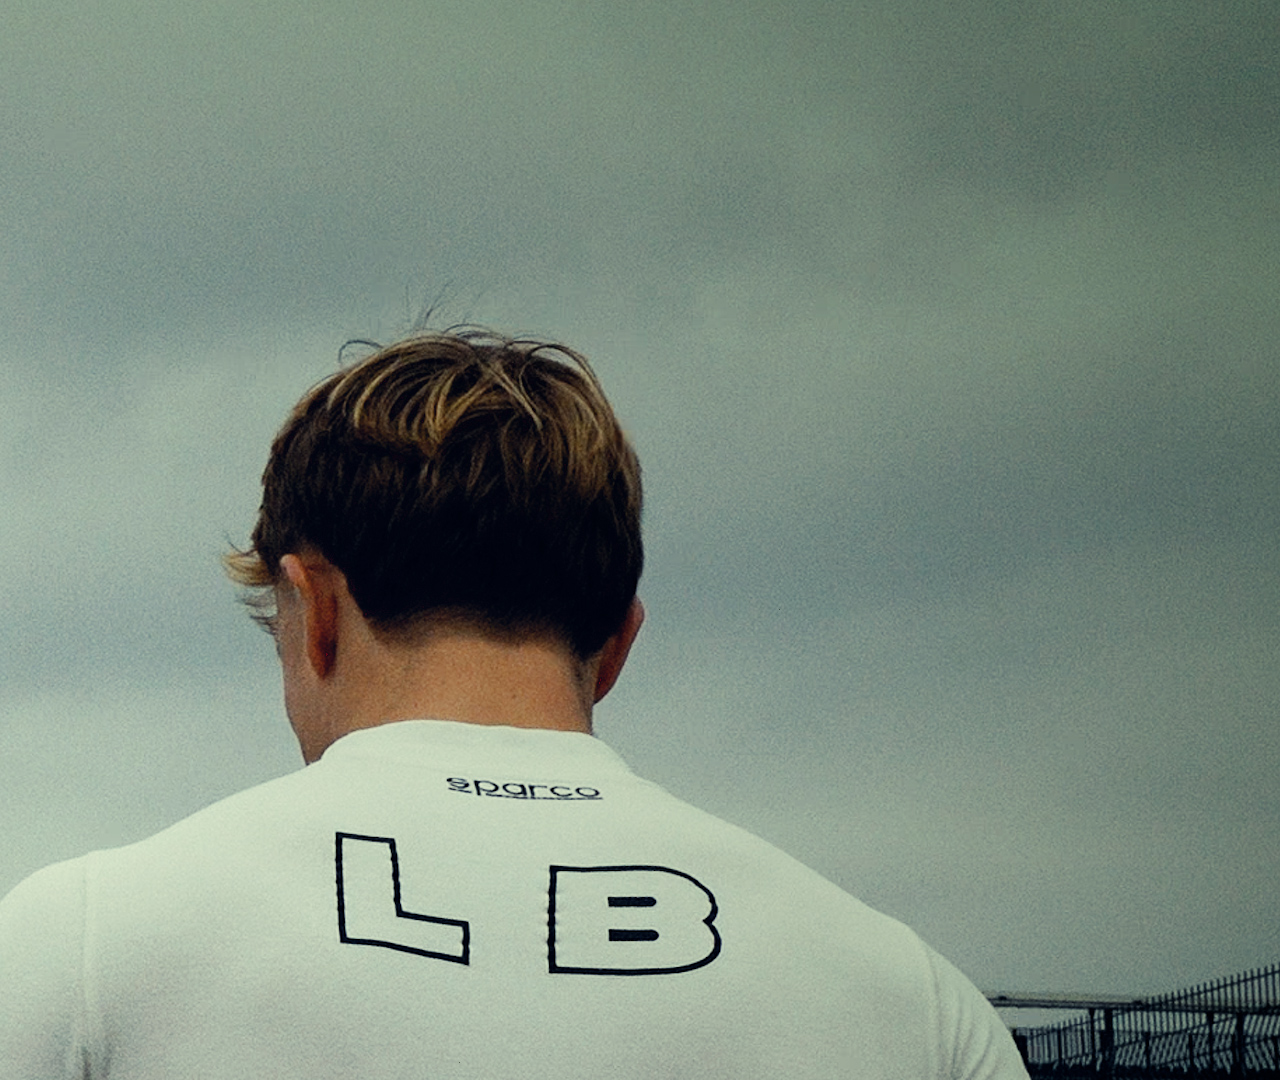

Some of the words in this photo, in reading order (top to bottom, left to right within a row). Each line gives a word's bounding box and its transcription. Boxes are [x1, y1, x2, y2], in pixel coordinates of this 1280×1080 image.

[446, 775, 603, 801] sparco
[335, 832, 470, 966] L
[547, 865, 722, 976] B
